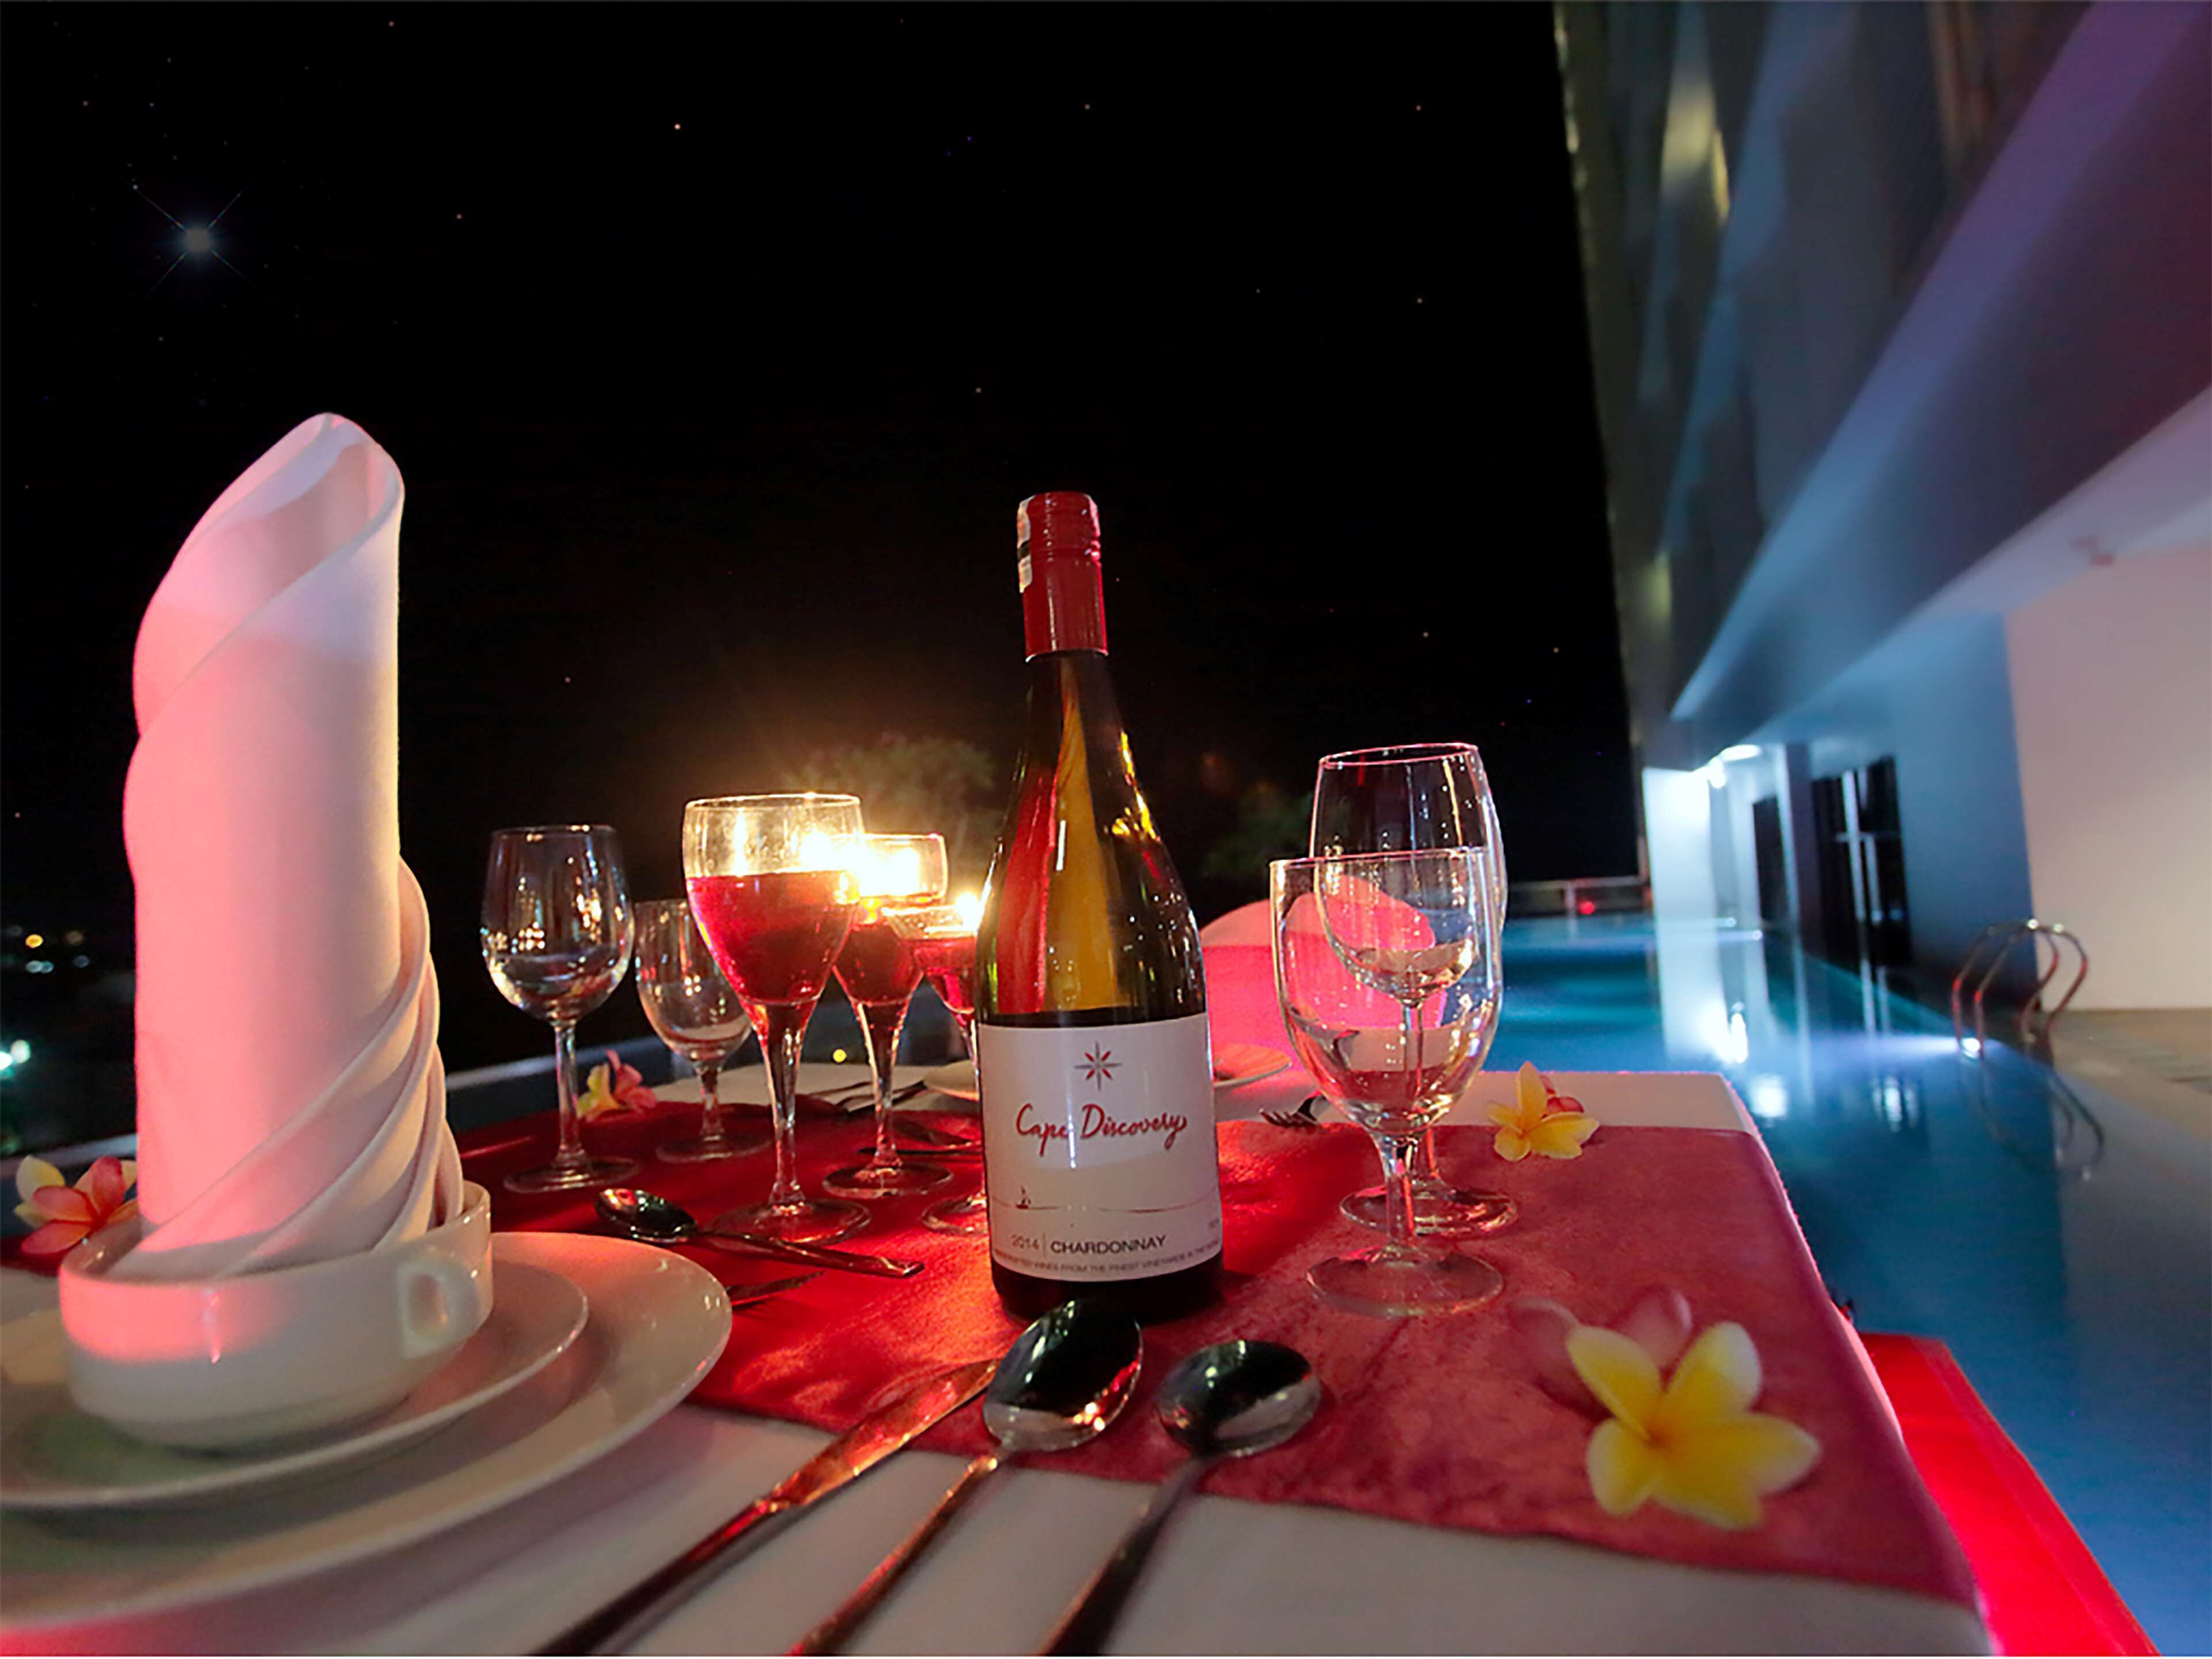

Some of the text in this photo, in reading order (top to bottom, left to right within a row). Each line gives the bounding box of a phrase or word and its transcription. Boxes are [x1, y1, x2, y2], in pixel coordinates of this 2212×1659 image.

[1016, 1103, 1188, 1157] Cape Discovery
[1012, 1234, 1166, 1254] 2014 CHARDONNAY
